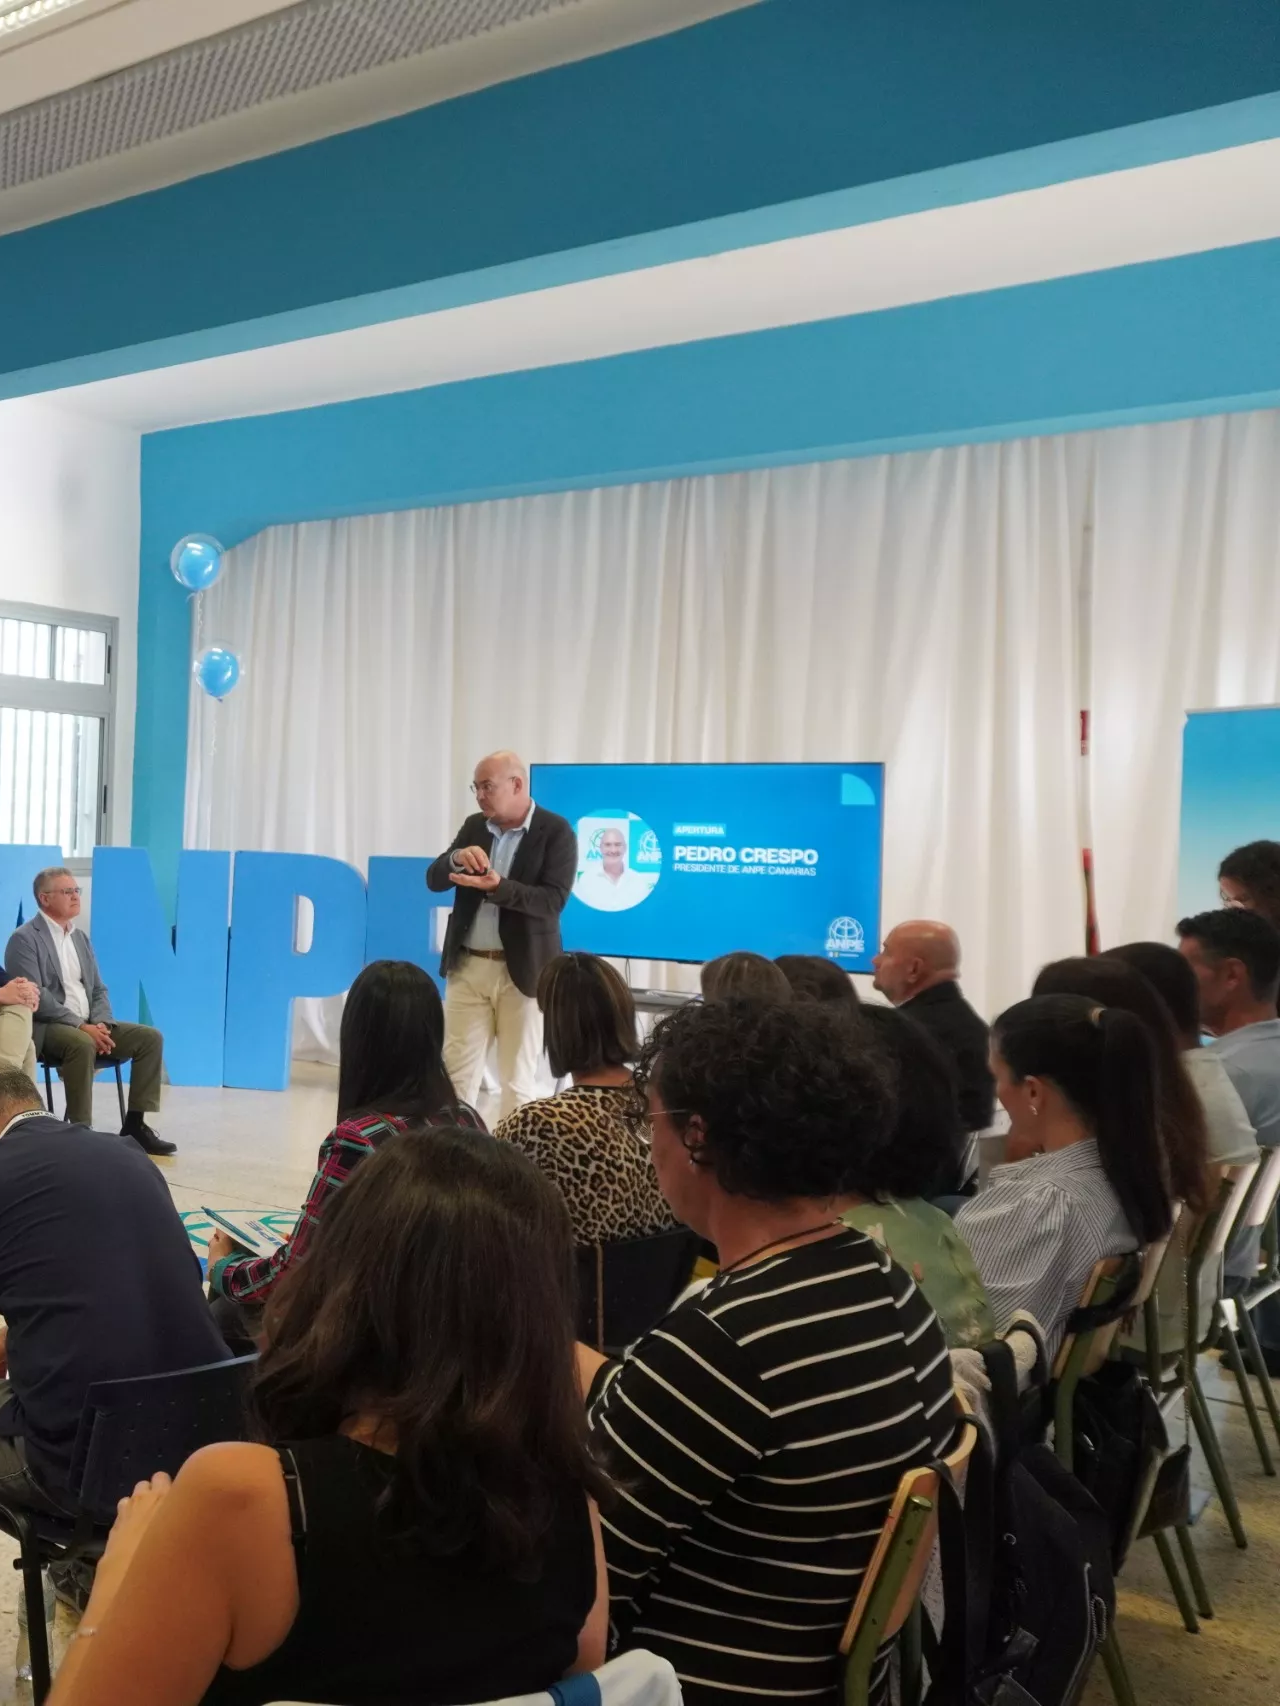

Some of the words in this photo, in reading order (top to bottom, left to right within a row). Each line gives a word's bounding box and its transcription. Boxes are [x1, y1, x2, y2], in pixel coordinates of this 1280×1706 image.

[674, 824, 725, 836] APERTURA
[673, 845, 737, 863] PEDRO
[739, 846, 818, 866] CRESPO
[674, 863, 726, 873] PRESIDENTE
[727, 864, 740, 874] DE
[741, 865, 766, 875] ANPE
[767, 866, 817, 877] CANARIAS
[825, 939, 865, 952] ANPE
